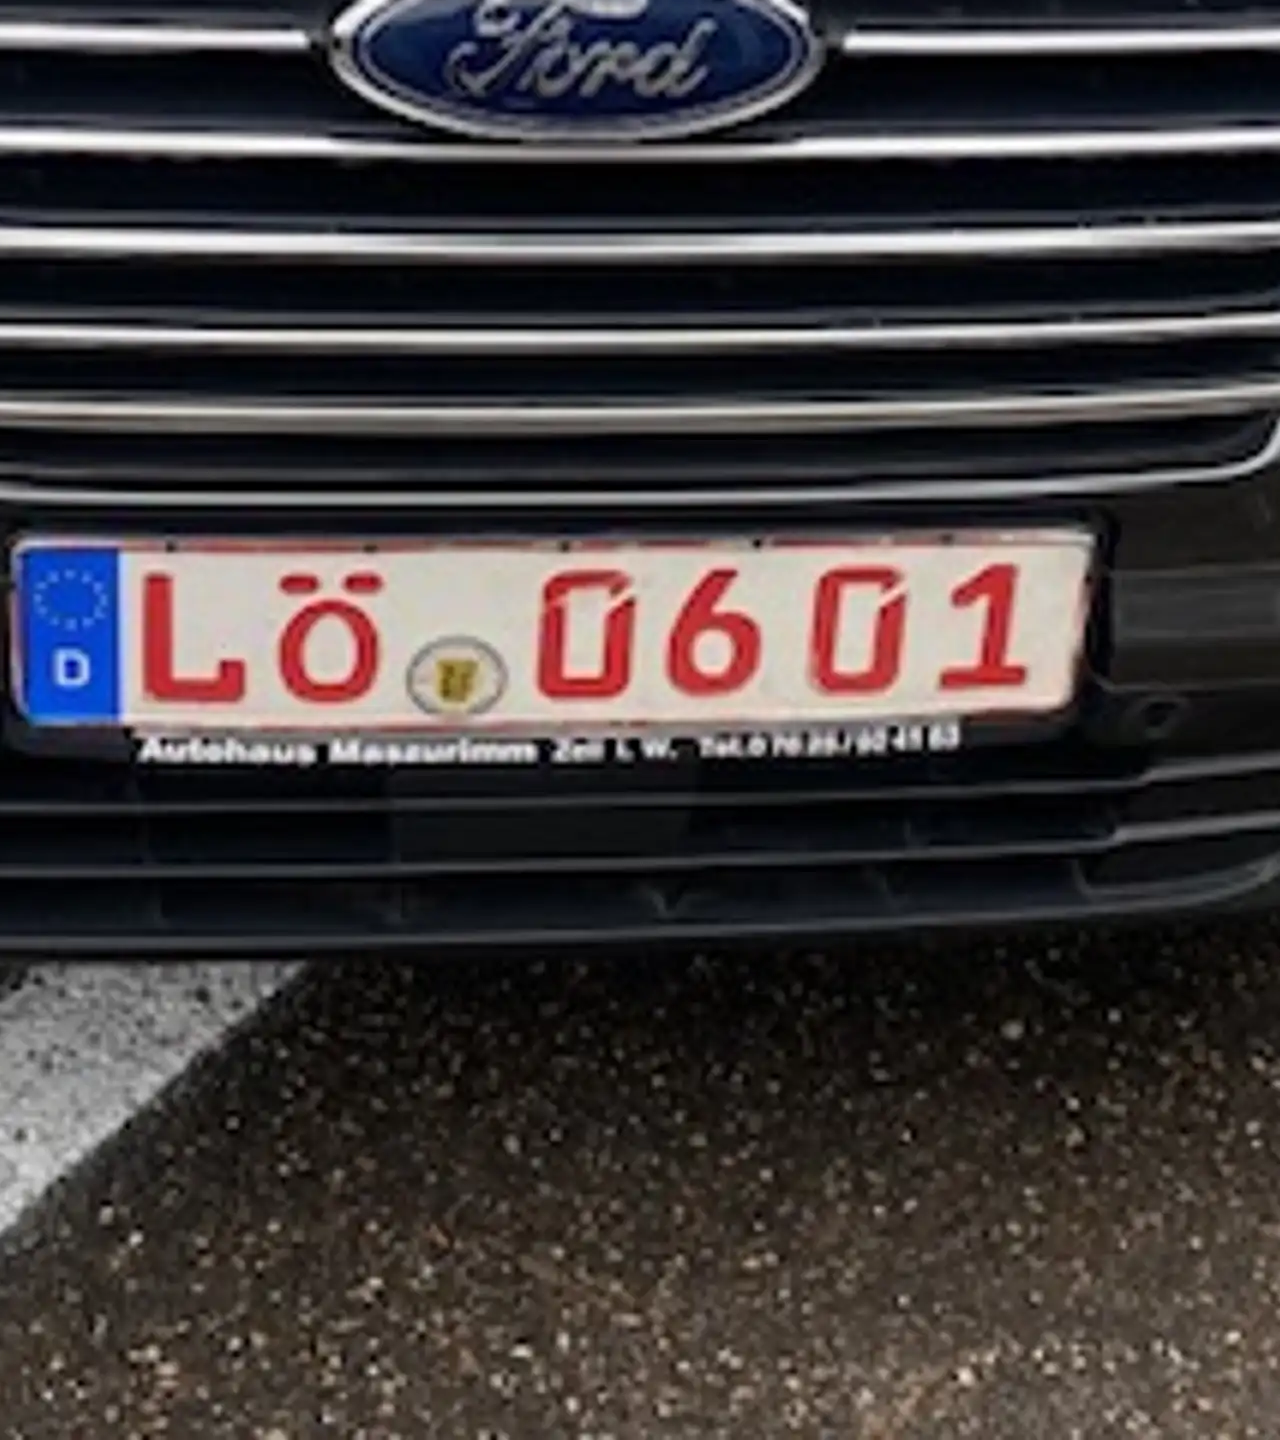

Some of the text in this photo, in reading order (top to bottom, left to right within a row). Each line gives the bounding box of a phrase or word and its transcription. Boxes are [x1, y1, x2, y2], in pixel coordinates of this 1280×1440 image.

[142, 563, 1028, 703] LÖ 0601
[54, 648, 90, 687] D
[139, 737, 317, 765] Autohaus
